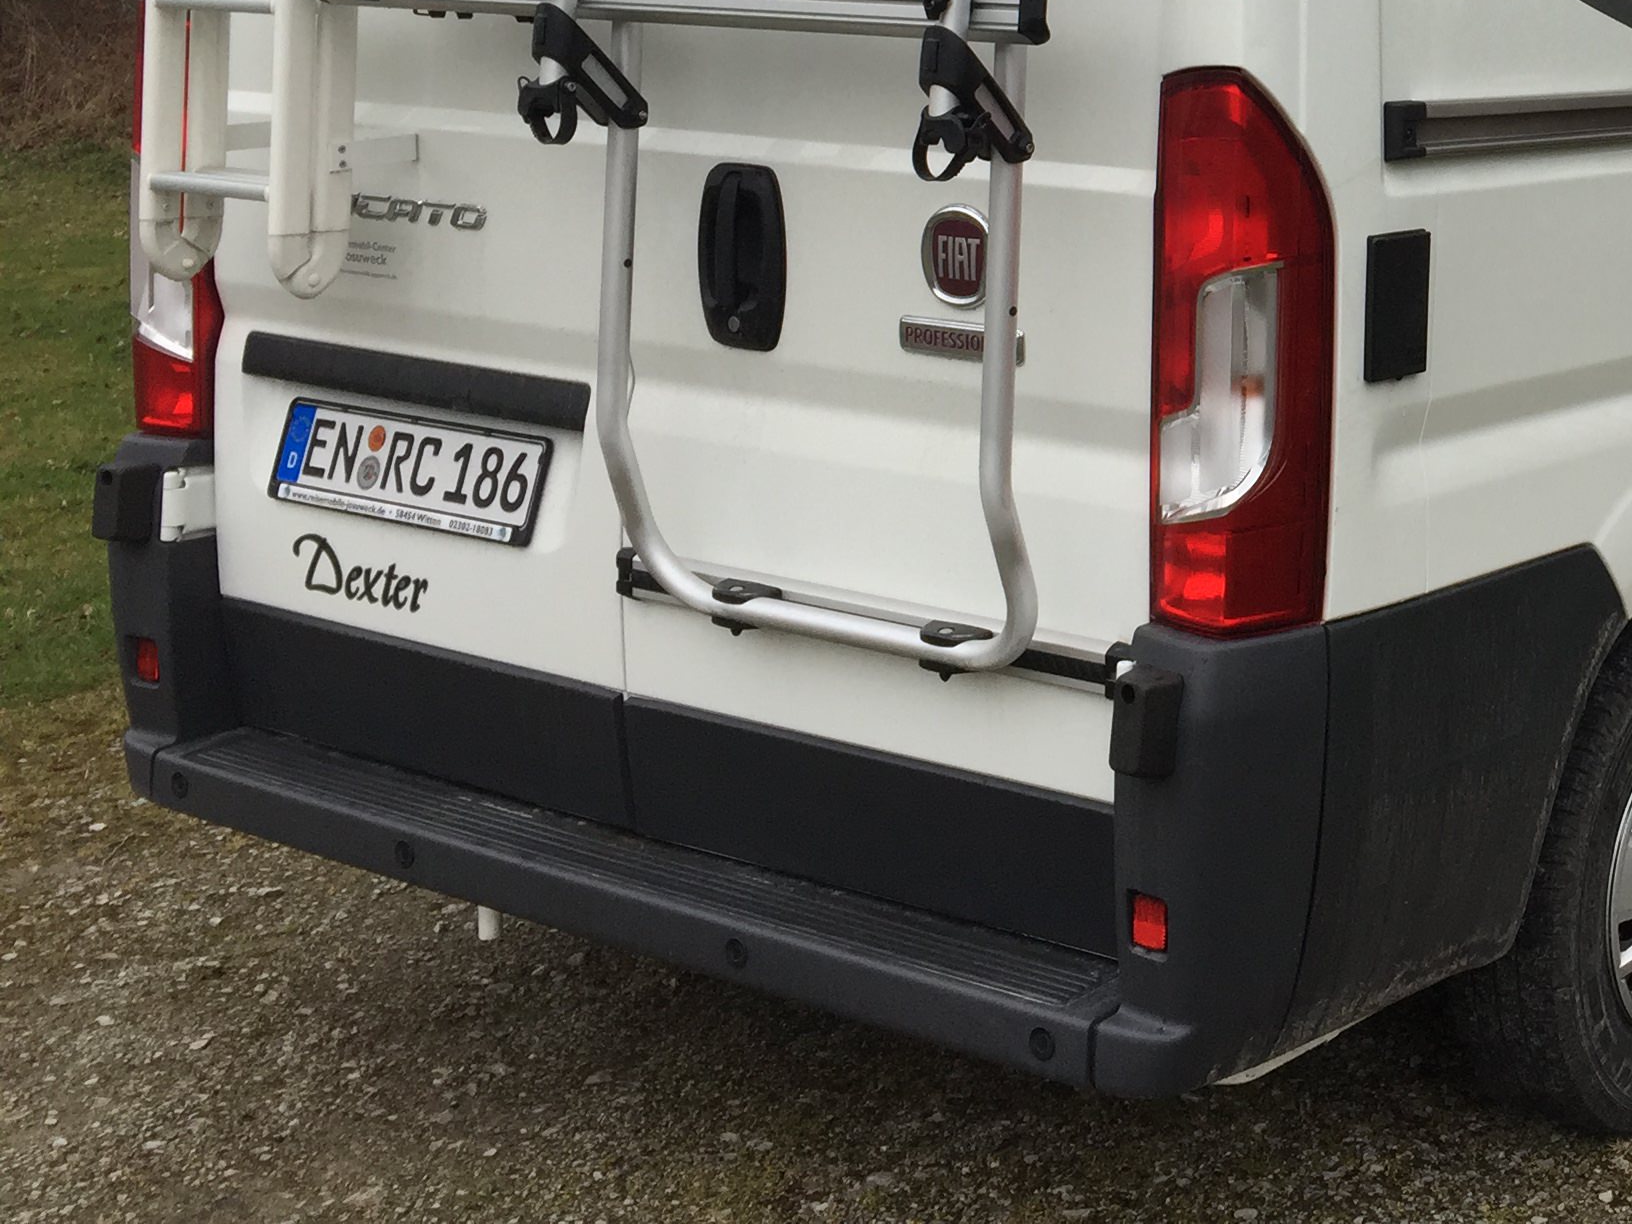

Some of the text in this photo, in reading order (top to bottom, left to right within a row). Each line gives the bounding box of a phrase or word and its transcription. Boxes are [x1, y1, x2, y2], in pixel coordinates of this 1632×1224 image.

[351, 192, 488, 231] CATO
[937, 234, 981, 281] FIAT
[287, 450, 298, 469] D
[301, 417, 529, 513] EN RC 186
[292, 532, 429, 613] Dexter
